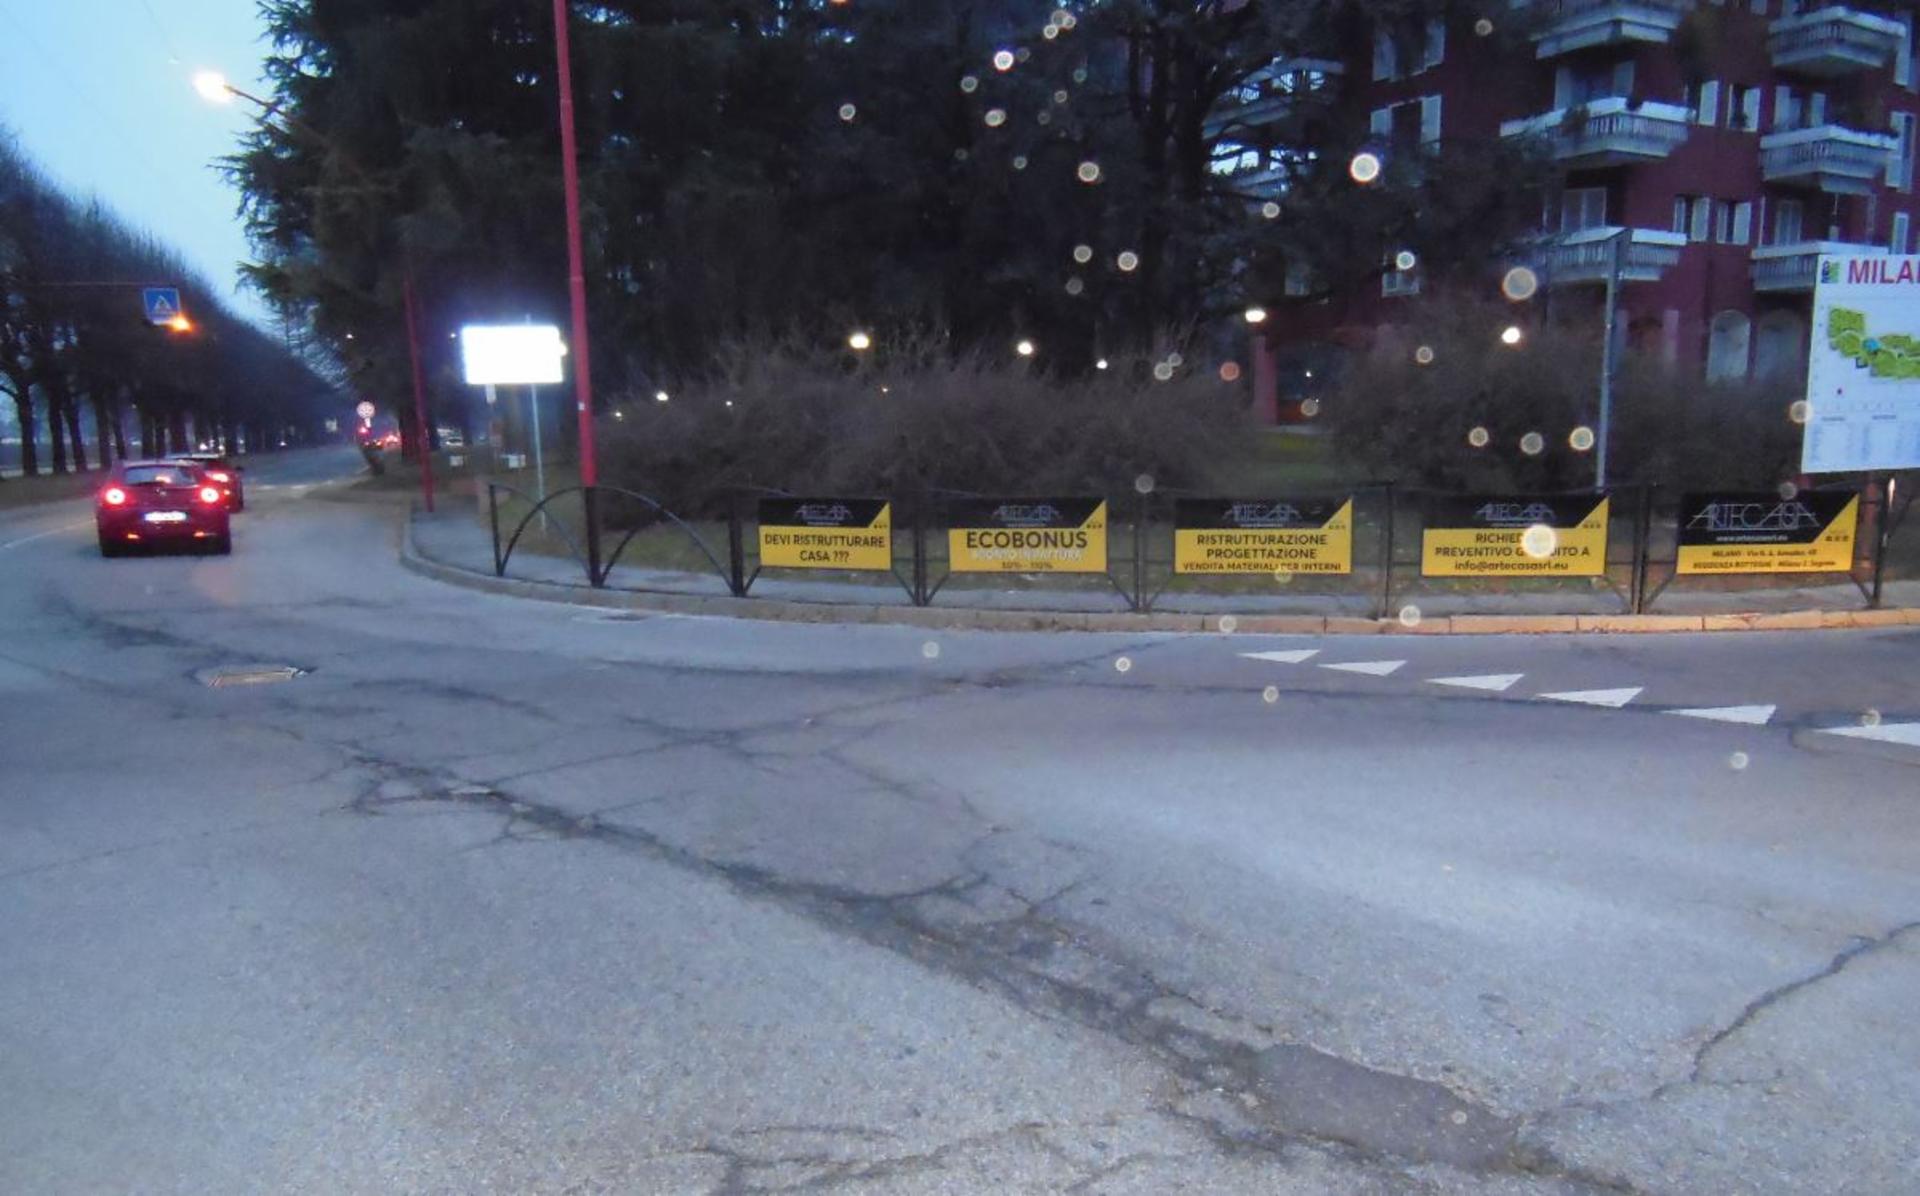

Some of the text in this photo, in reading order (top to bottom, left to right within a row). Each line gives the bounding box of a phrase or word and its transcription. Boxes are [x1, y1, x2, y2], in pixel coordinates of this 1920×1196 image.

[1686, 502, 1820, 531] ARTECASA
[764, 534, 885, 548] DEVI RISTRUTTURARE
[966, 531, 1088, 549] ECOBONUS
[1197, 534, 1327, 545] RISTRUTTURAZIONE
[800, 550, 850, 562] CASA ???
[1207, 549, 1317, 559] PROGETTAZIONE
[1435, 546, 1512, 556] PREVENTIVO
[1581, 546, 1590, 556] A
[1183, 562, 1224, 571] VENDITA
[1227, 562, 1277, 571] MATERIALI
[1302, 562, 1341, 571] INTERNI
[1455, 559, 1569, 573] info@artecasasrl.eu
